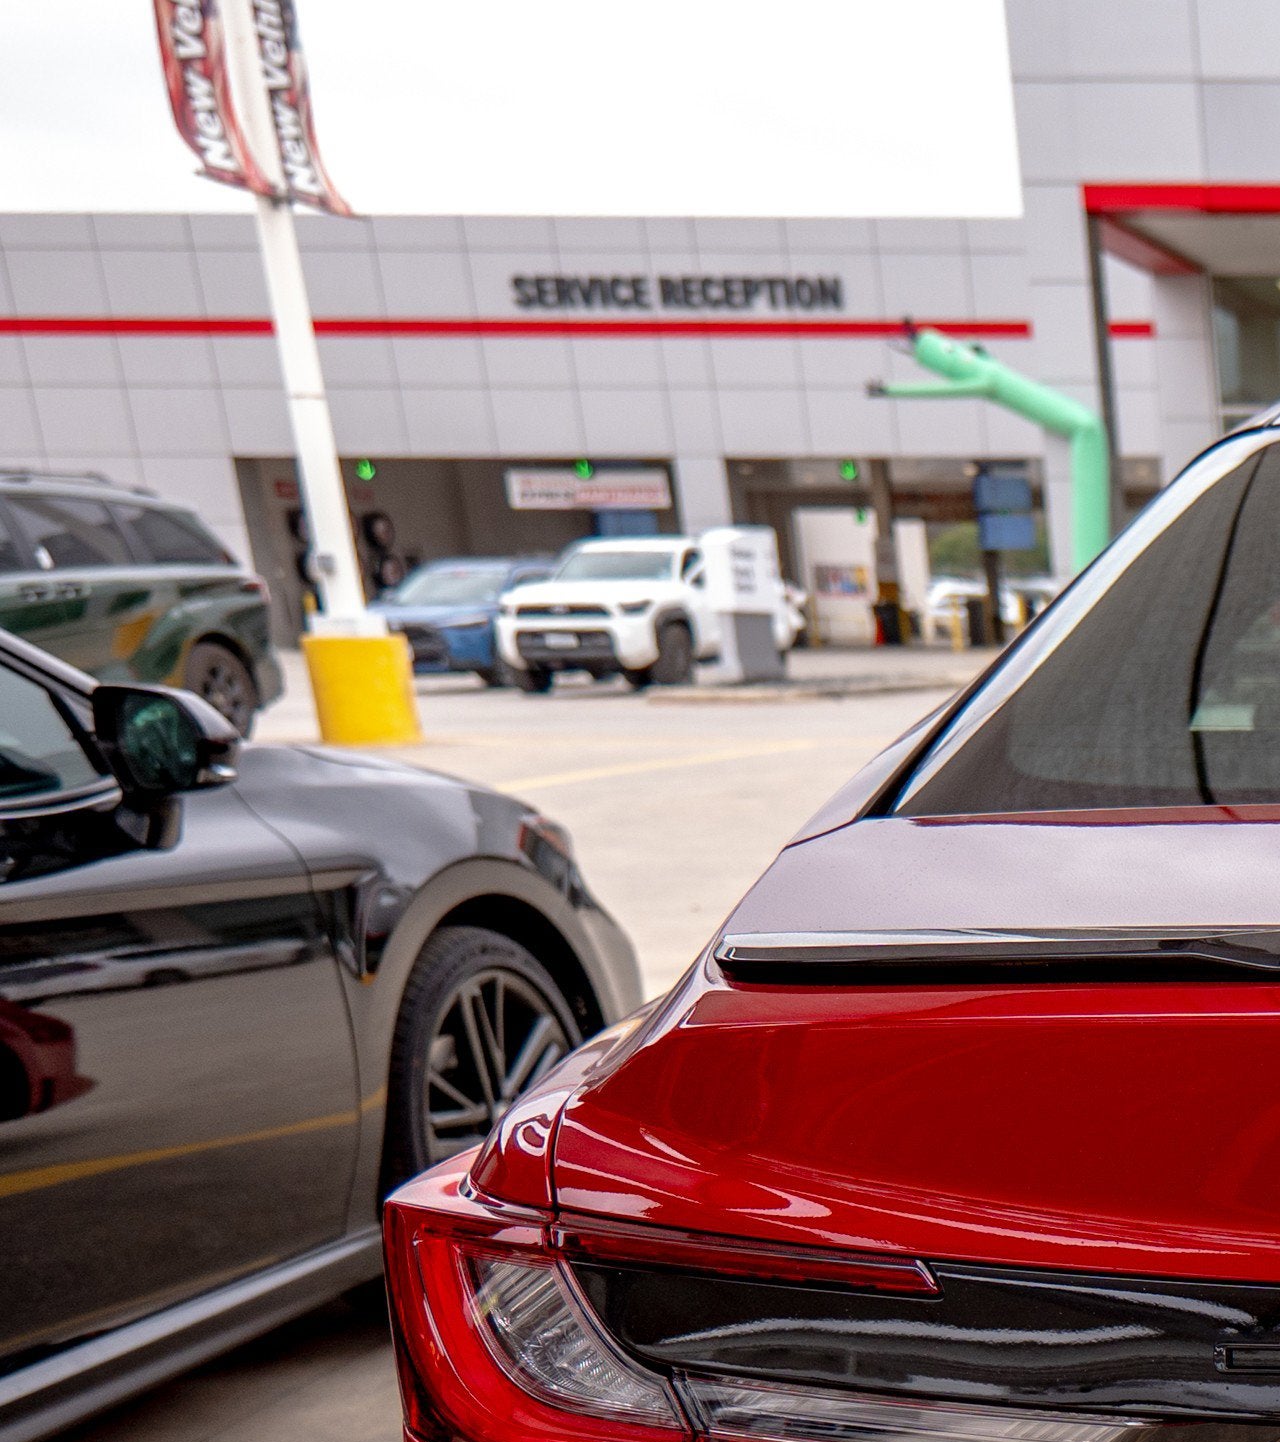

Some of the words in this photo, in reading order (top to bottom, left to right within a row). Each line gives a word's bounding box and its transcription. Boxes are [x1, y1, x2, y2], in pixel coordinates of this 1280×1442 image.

[172, 0, 208, 59] Ve
[184, 64, 239, 170] New
[271, 93, 326, 196] New
[512, 275, 650, 309] SERVICE
[659, 276, 844, 309] RECEPTION
